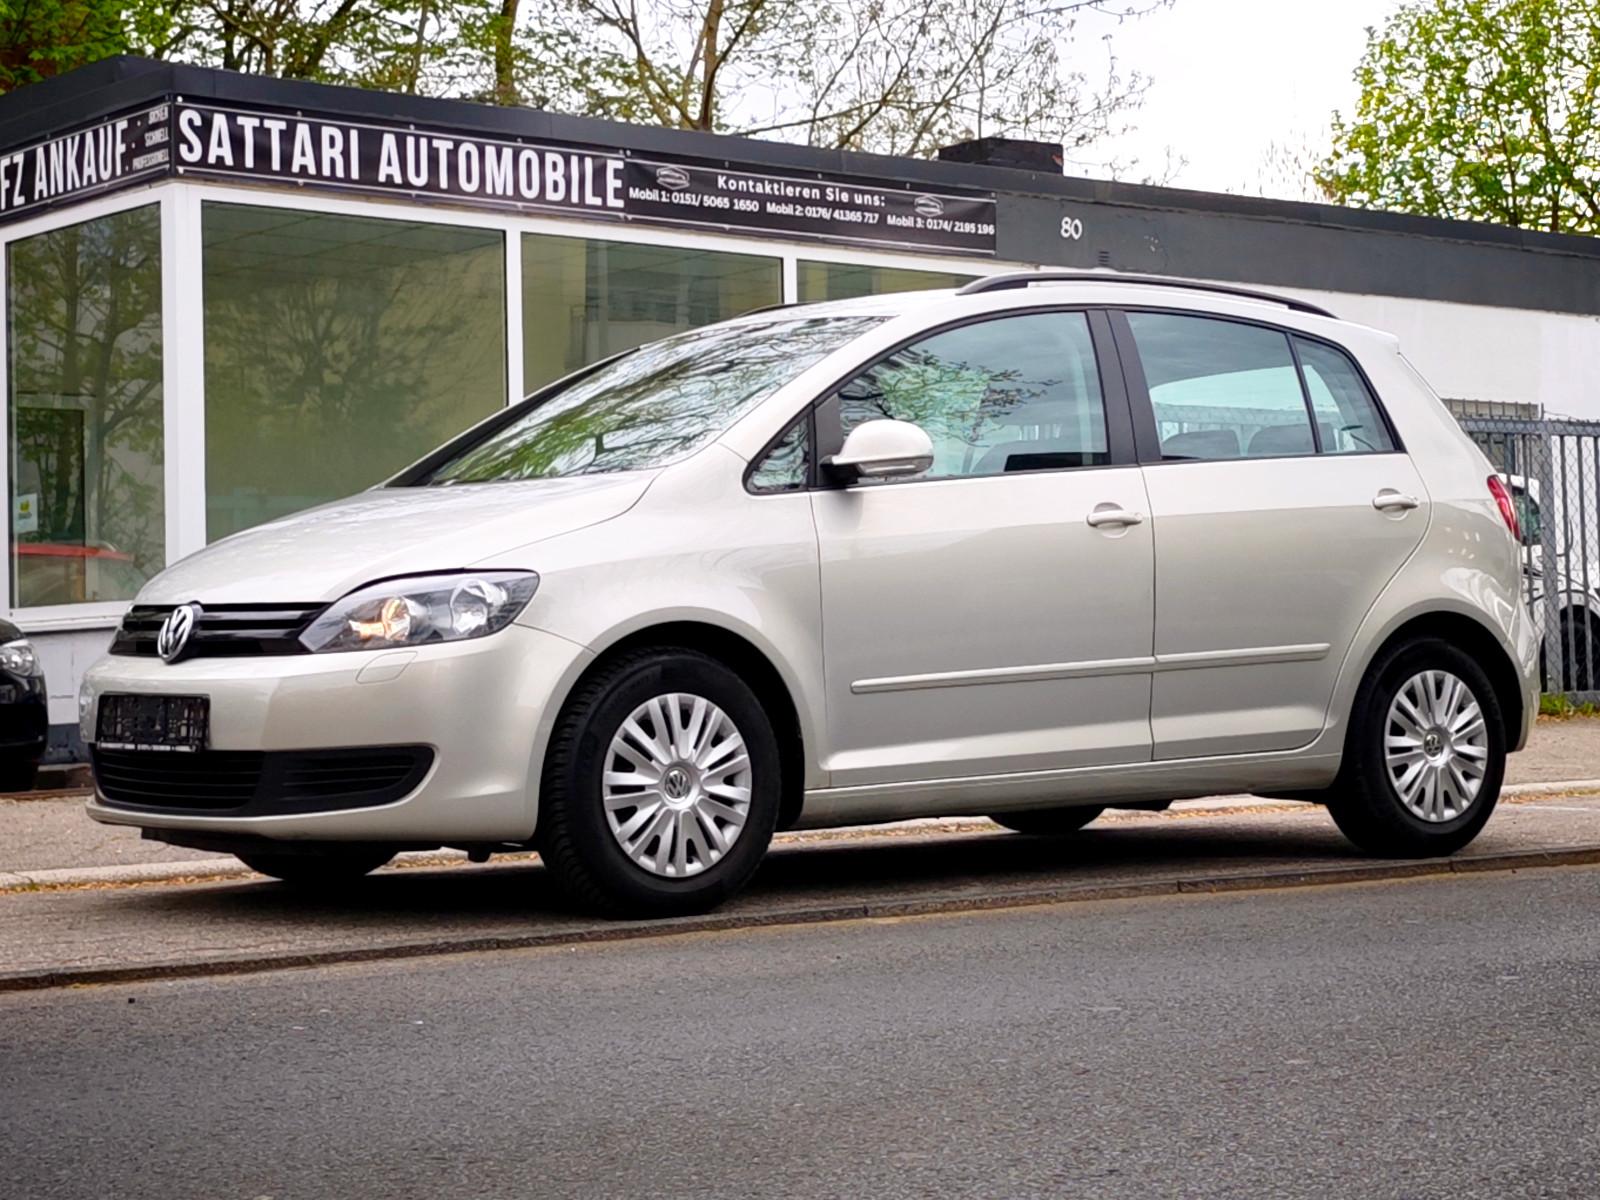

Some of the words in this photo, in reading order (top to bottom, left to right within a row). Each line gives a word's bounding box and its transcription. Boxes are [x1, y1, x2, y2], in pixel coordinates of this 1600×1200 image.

[34, 120, 128, 201] ANKAUF
[178, 110, 359, 180] SATTARI
[378, 133, 625, 208] AUTOMOBILE
[628, 187, 659, 202] Mobil
[661, 191, 670, 202] 1:
[671, 192, 701, 207] 0151/
[703, 195, 730, 209] 5065
[733, 199, 760, 212] 1650
[766, 201, 794, 215] Mobil
[833, 209, 862, 223] 41365
[887, 214, 915, 228] Mobil
[954, 221, 976, 234] 2195
[977, 223, 995, 235] 196
[717, 175, 820, 200] Kontaktieren
[825, 187, 849, 203] Sie
[854, 193, 885, 207] uns:
[1060, 216, 1083, 240] 80
